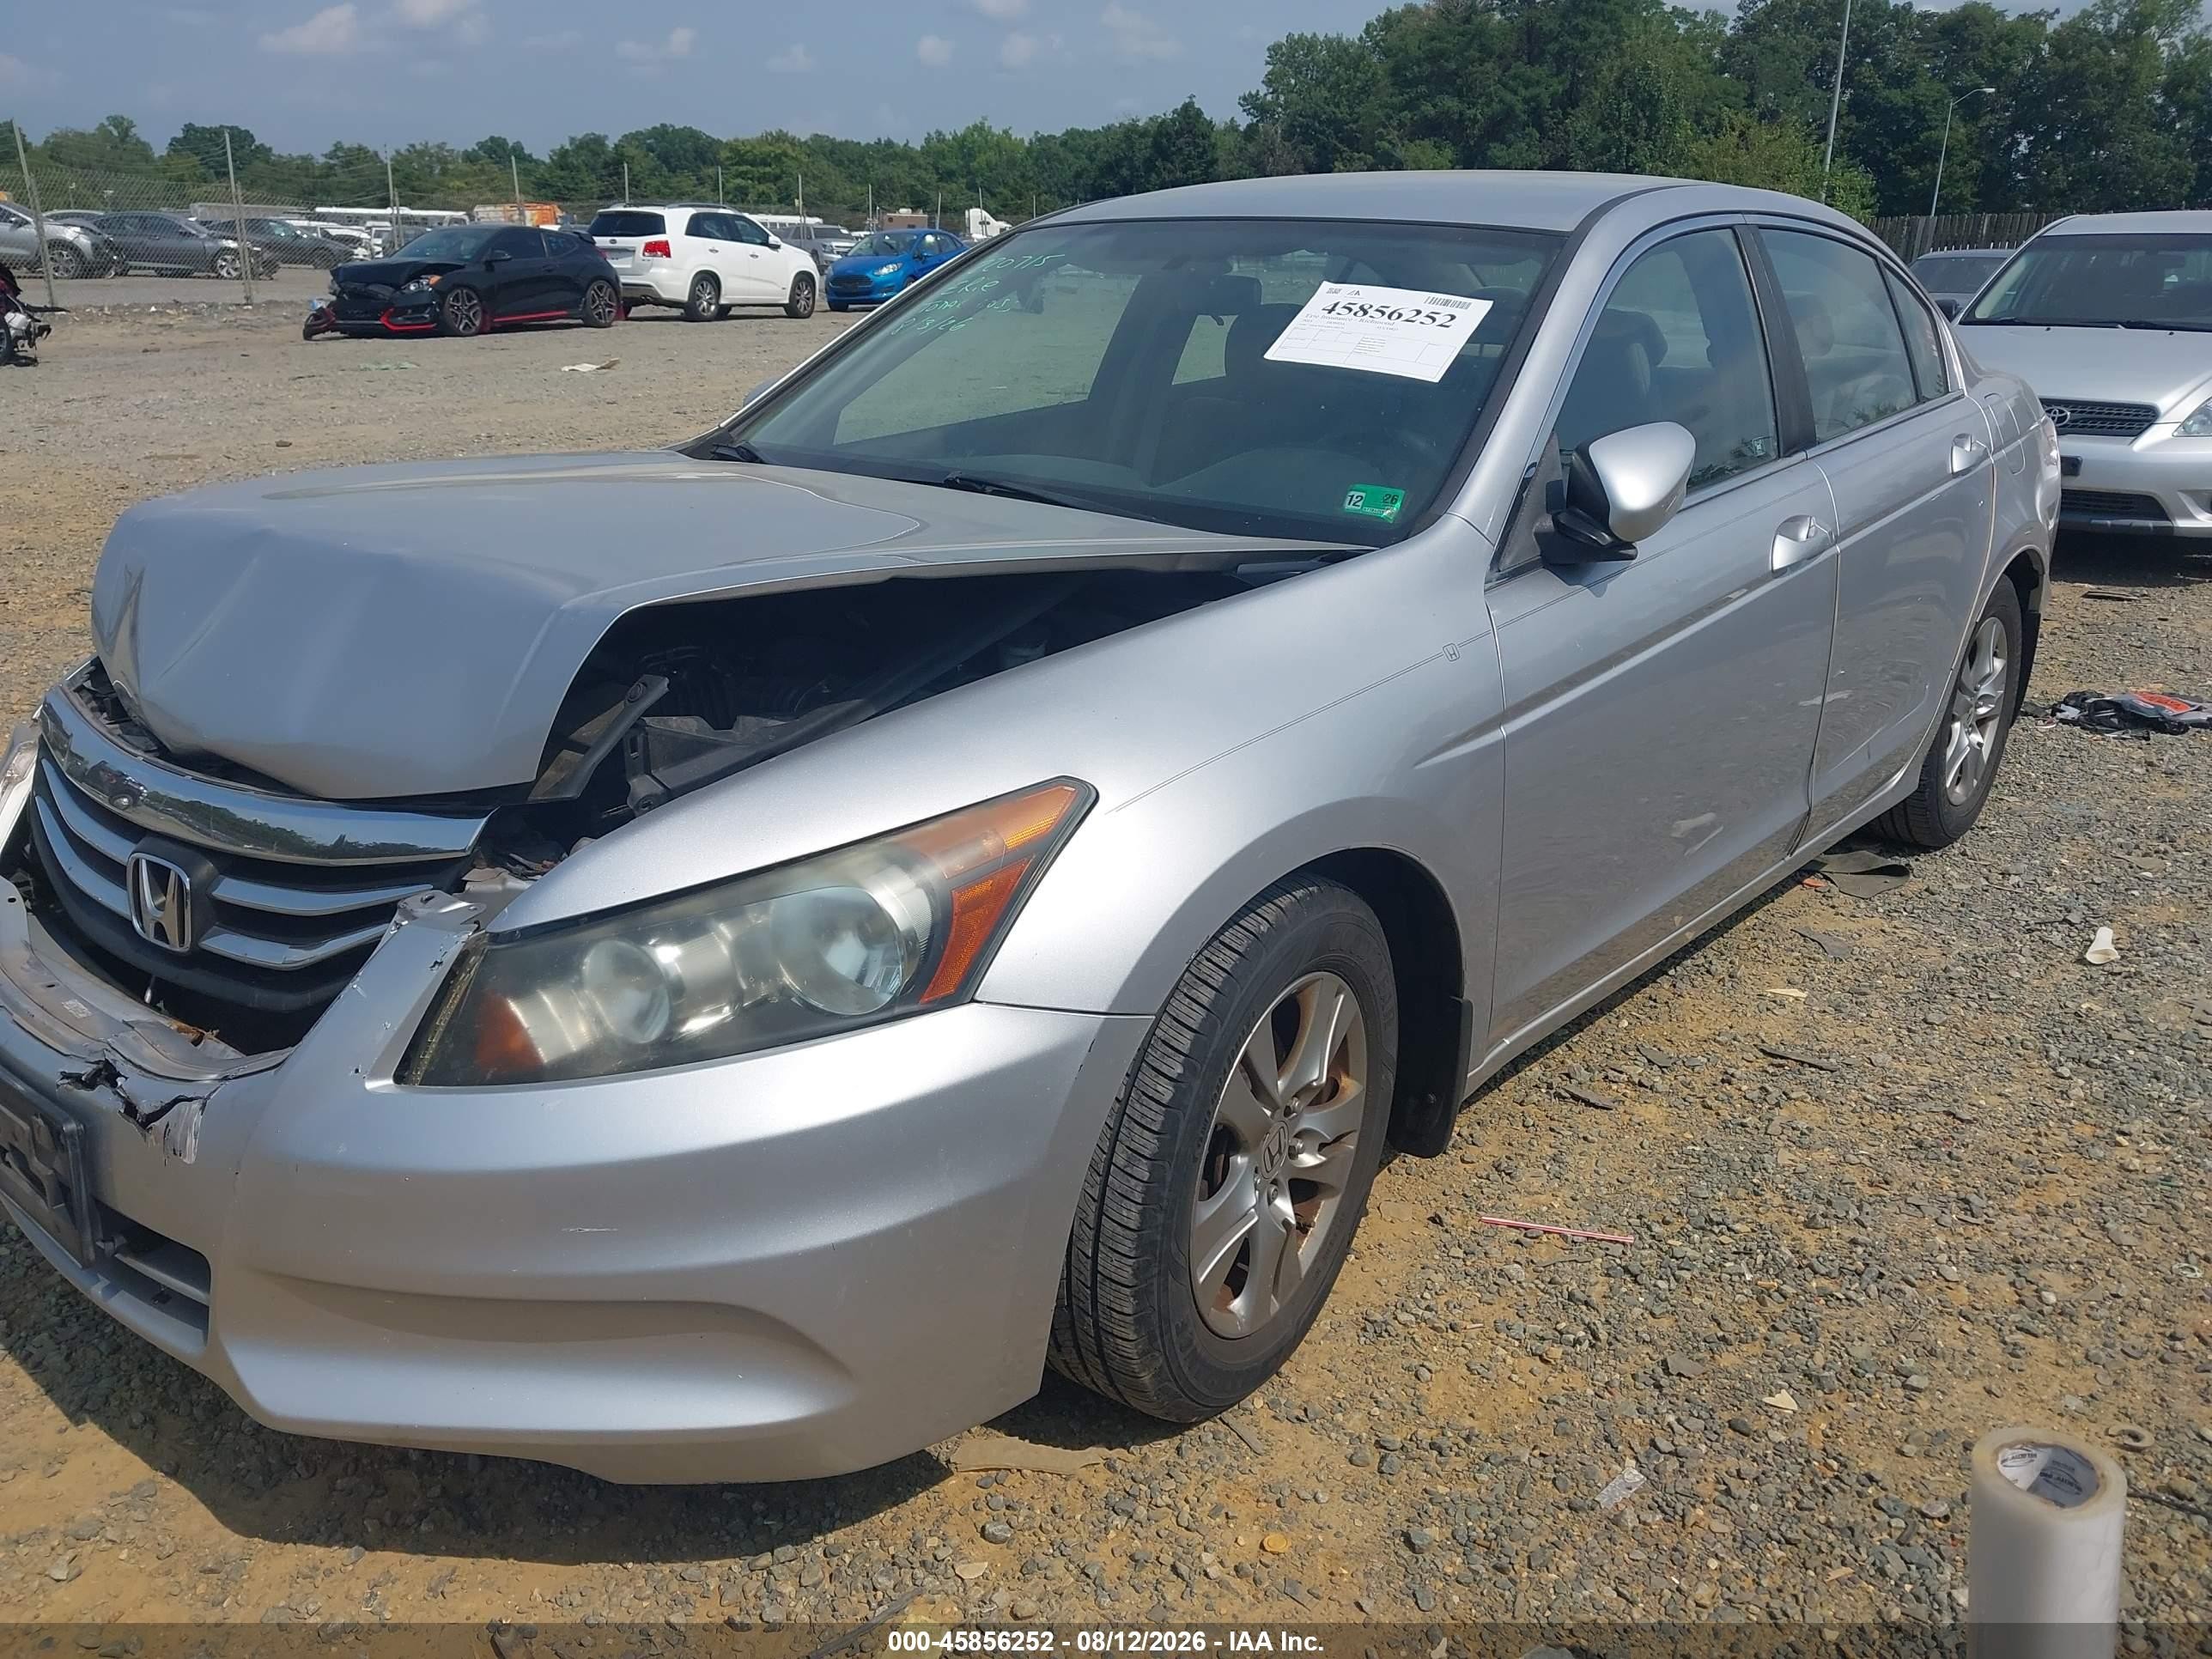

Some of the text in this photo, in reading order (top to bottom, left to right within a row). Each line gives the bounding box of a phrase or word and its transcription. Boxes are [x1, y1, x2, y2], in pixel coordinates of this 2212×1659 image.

[1321, 301, 1457, 329] 45856252
[1347, 494, 1364, 507] 12
[1382, 493, 1400, 505] 26
